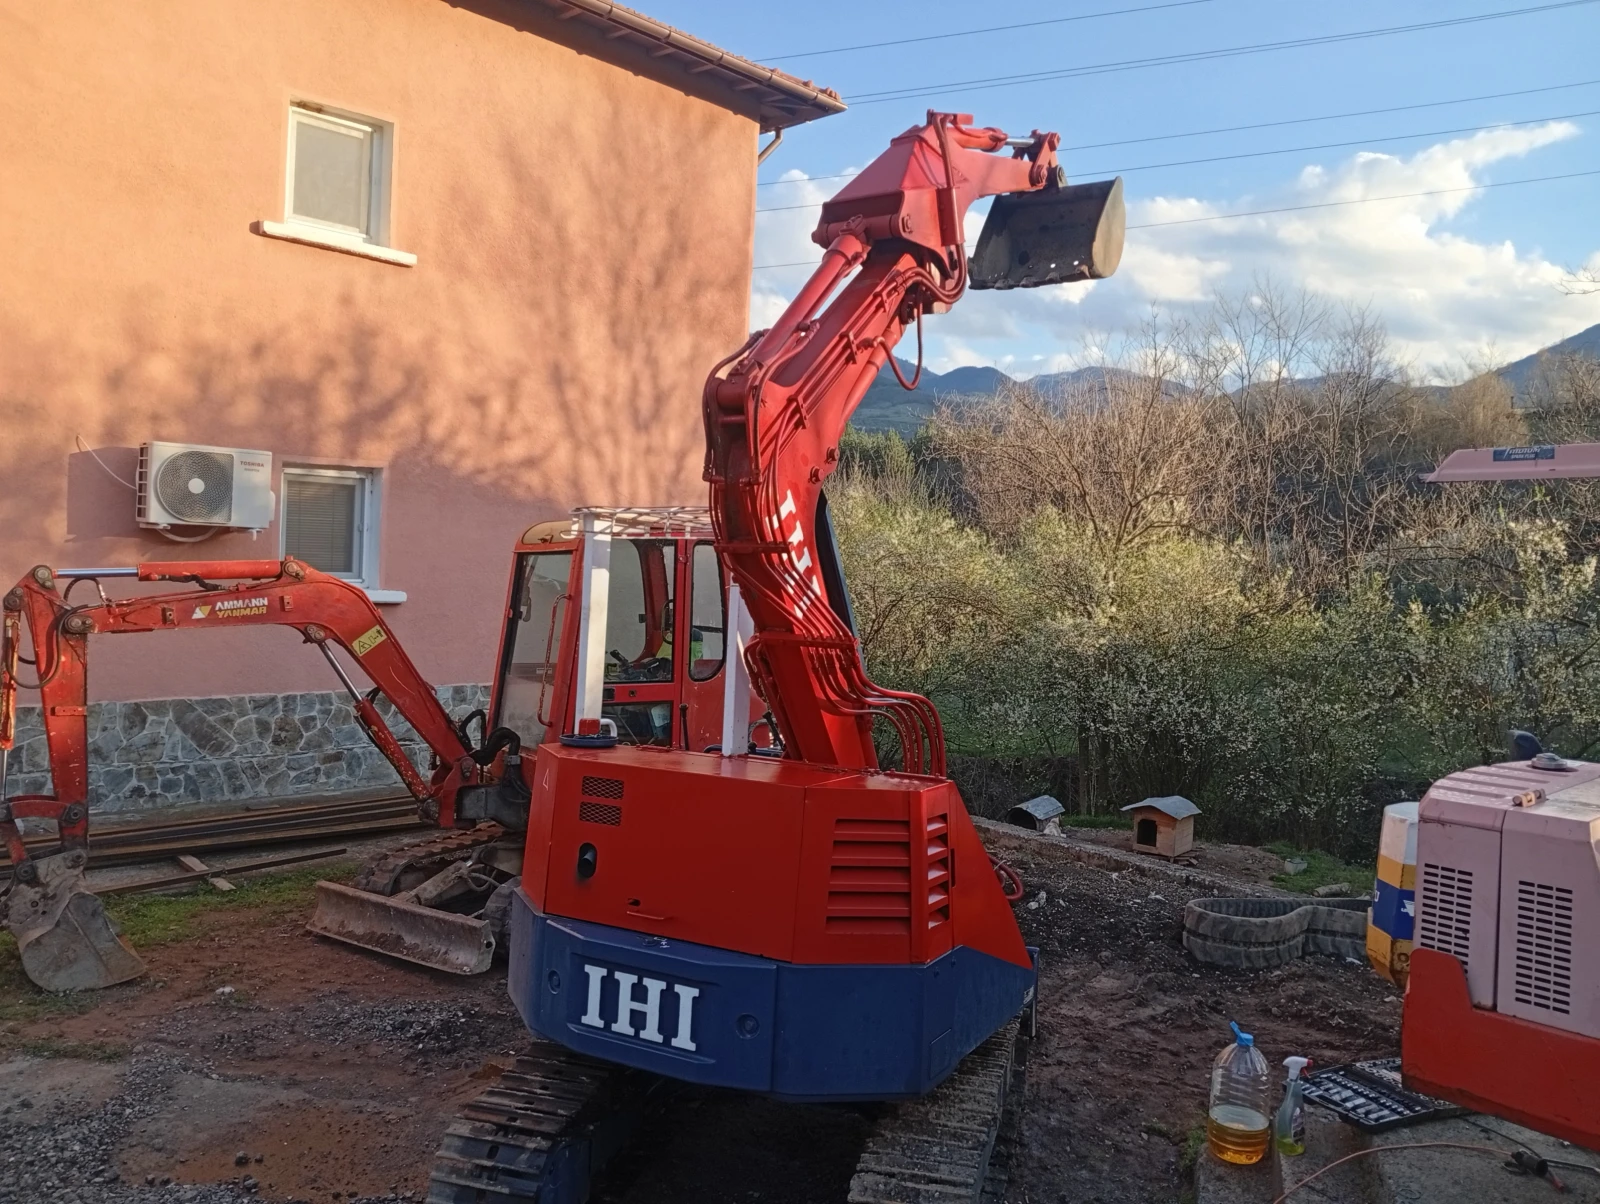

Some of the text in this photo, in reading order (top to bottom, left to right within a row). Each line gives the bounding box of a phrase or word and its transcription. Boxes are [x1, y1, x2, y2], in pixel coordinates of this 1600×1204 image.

[240, 460, 265, 468] TOSHIBA
[215, 597, 268, 611] AMMANN
[216, 606, 267, 618] YANMAR
[581, 964, 700, 1052] IHI
